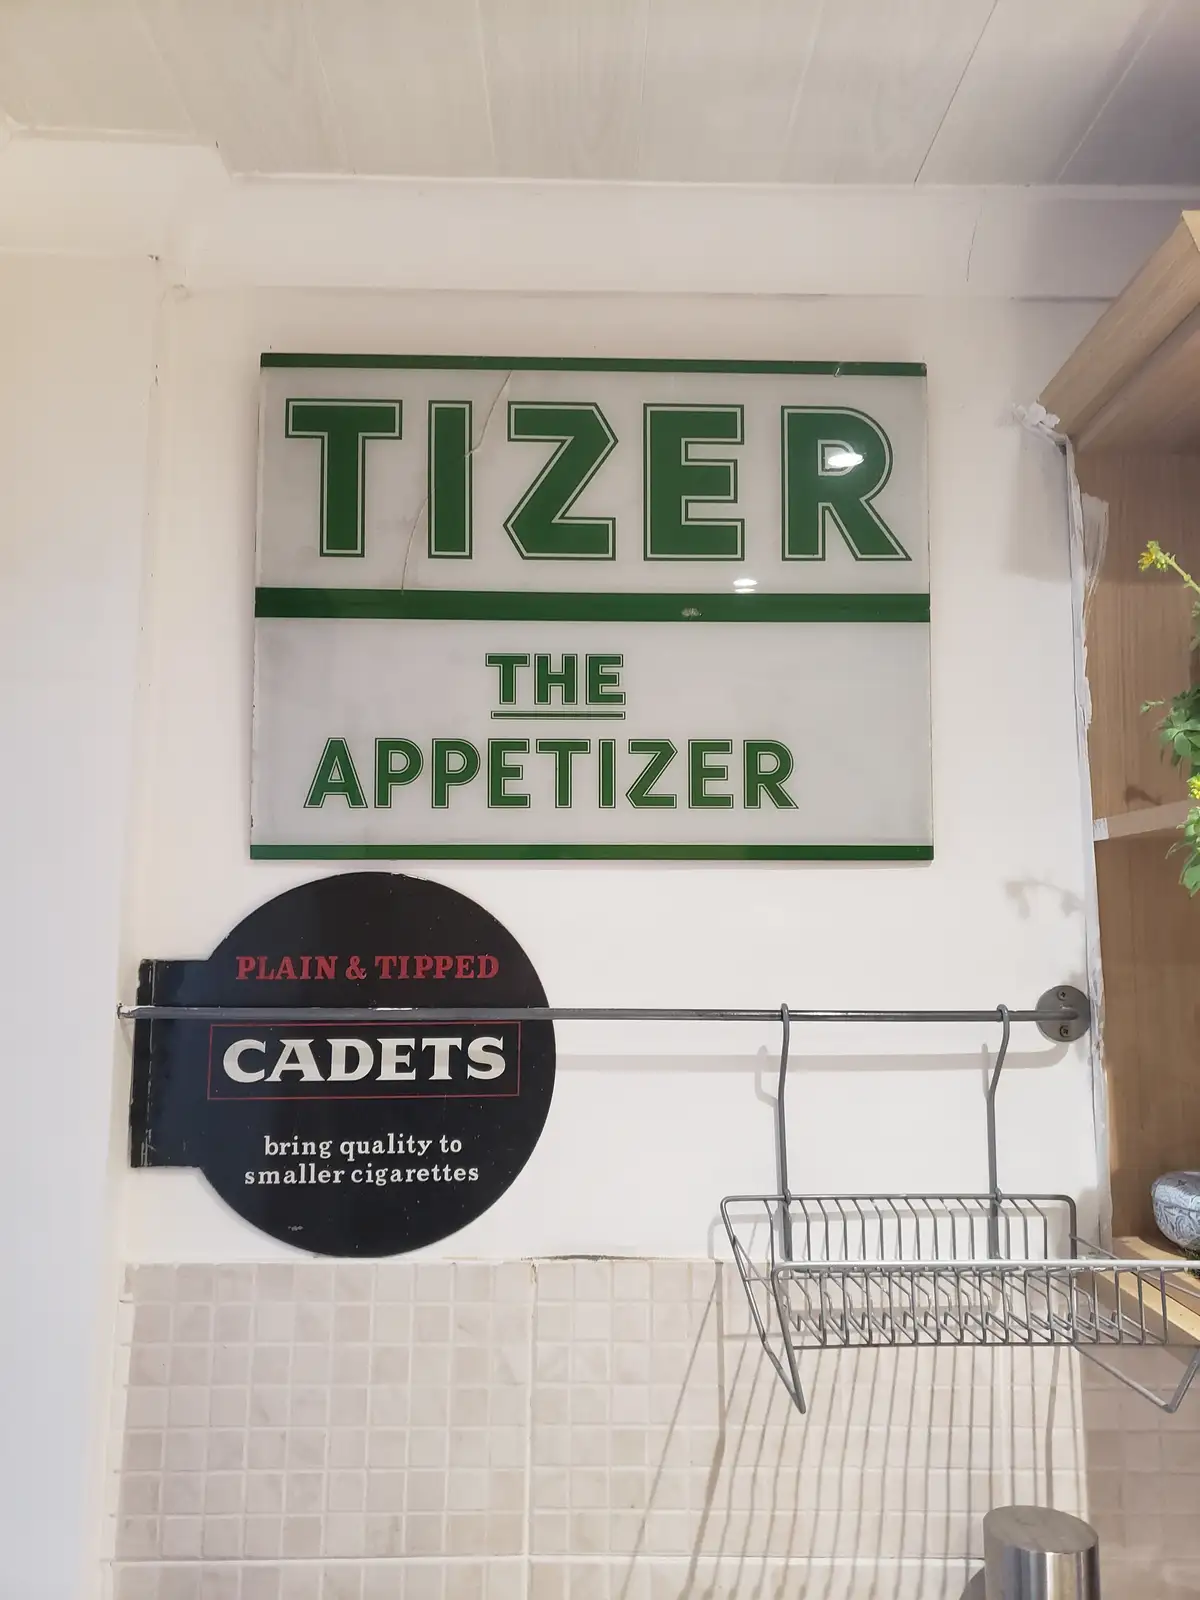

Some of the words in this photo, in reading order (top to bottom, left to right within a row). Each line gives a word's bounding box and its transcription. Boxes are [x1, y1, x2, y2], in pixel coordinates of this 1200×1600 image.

[285, 398, 912, 562] TIZER
[485, 653, 626, 705] THE
[303, 737, 799, 810] APPETIZER
[235, 955, 338, 981] PLAIN
[345, 955, 367, 980] &
[375, 954, 500, 980] TIPPED
[222, 1036, 506, 1083] CADETS
[263, 1135, 332, 1160] bring
[339, 1133, 433, 1162] quality
[439, 1135, 463, 1155] to
[244, 1163, 345, 1186] smaller
[350, 1163, 480, 1187] cigarettes
